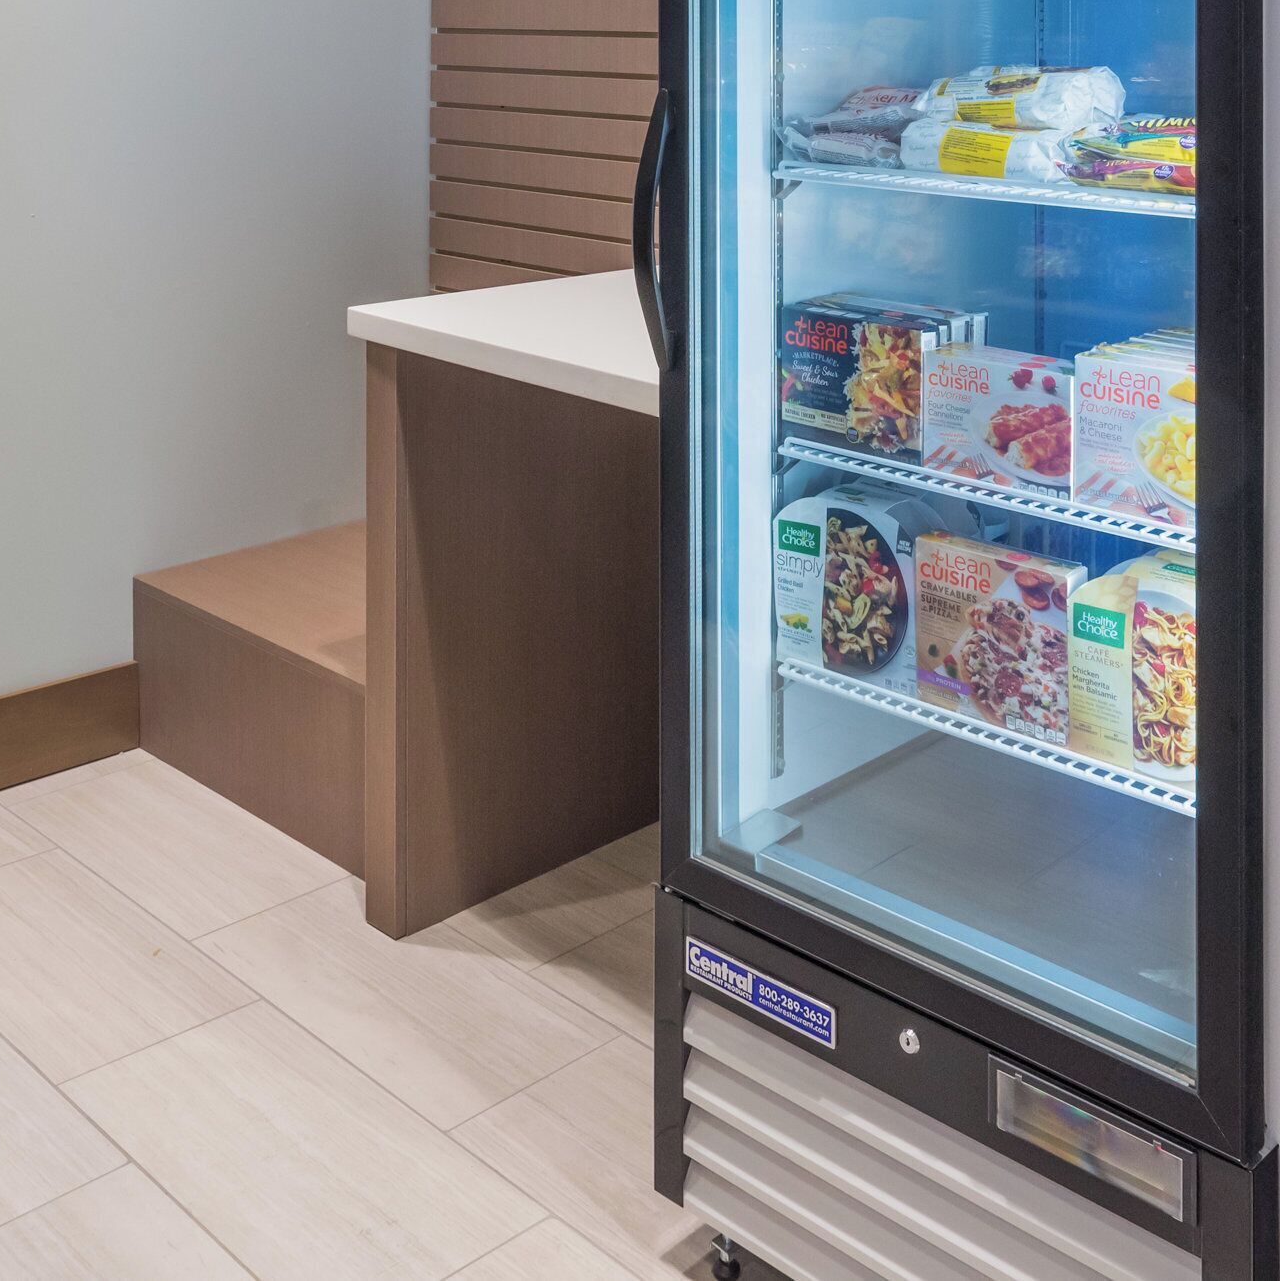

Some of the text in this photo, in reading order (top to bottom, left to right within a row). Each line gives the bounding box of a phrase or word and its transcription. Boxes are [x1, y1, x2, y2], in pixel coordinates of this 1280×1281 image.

[808, 319, 847, 339] Lean
[792, 361, 812, 373] Sweet
[822, 368, 838, 378] Sour
[951, 362, 988, 380] Lean
[802, 373, 829, 386] Chicken
[1109, 369, 1160, 392] Lean
[927, 387, 972, 403] favorites
[928, 401, 969, 414] Four Cheese
[928, 409, 963, 421] Cannelloni
[1078, 400, 1136, 420] favorites
[1080, 417, 1122, 432] Macaroni
[1088, 428, 1122, 442] Cheese
[782, 534, 815, 549] Choice
[786, 526, 814, 540] Healthy
[776, 553, 823, 578] simply
[945, 552, 991, 578] Lean
[778, 577, 792, 586] Grilled
[778, 584, 794, 593] Chicken
[921, 581, 977, 603] CRAVEABLES
[921, 594, 961, 614] SUPREME
[928, 605, 952, 618] PIZZA
[1082, 611, 1117, 629] Healthy
[1077, 620, 1118, 639] Choice
[1074, 651, 1120, 668] STEAMERS
[1087, 646, 1109, 658] CAFÉ
[1072, 665, 1100, 679] Chicken
[1072, 673, 1110, 690] Margherita
[1073, 684, 1117, 700] with Balsamic
[690, 946, 753, 994] Central
[690, 965, 752, 1001] RESTAURANT PRODUCTS
[759, 984, 829, 1026] 800-289-3637
[759, 997, 829, 1037] centralrestaurant.com
